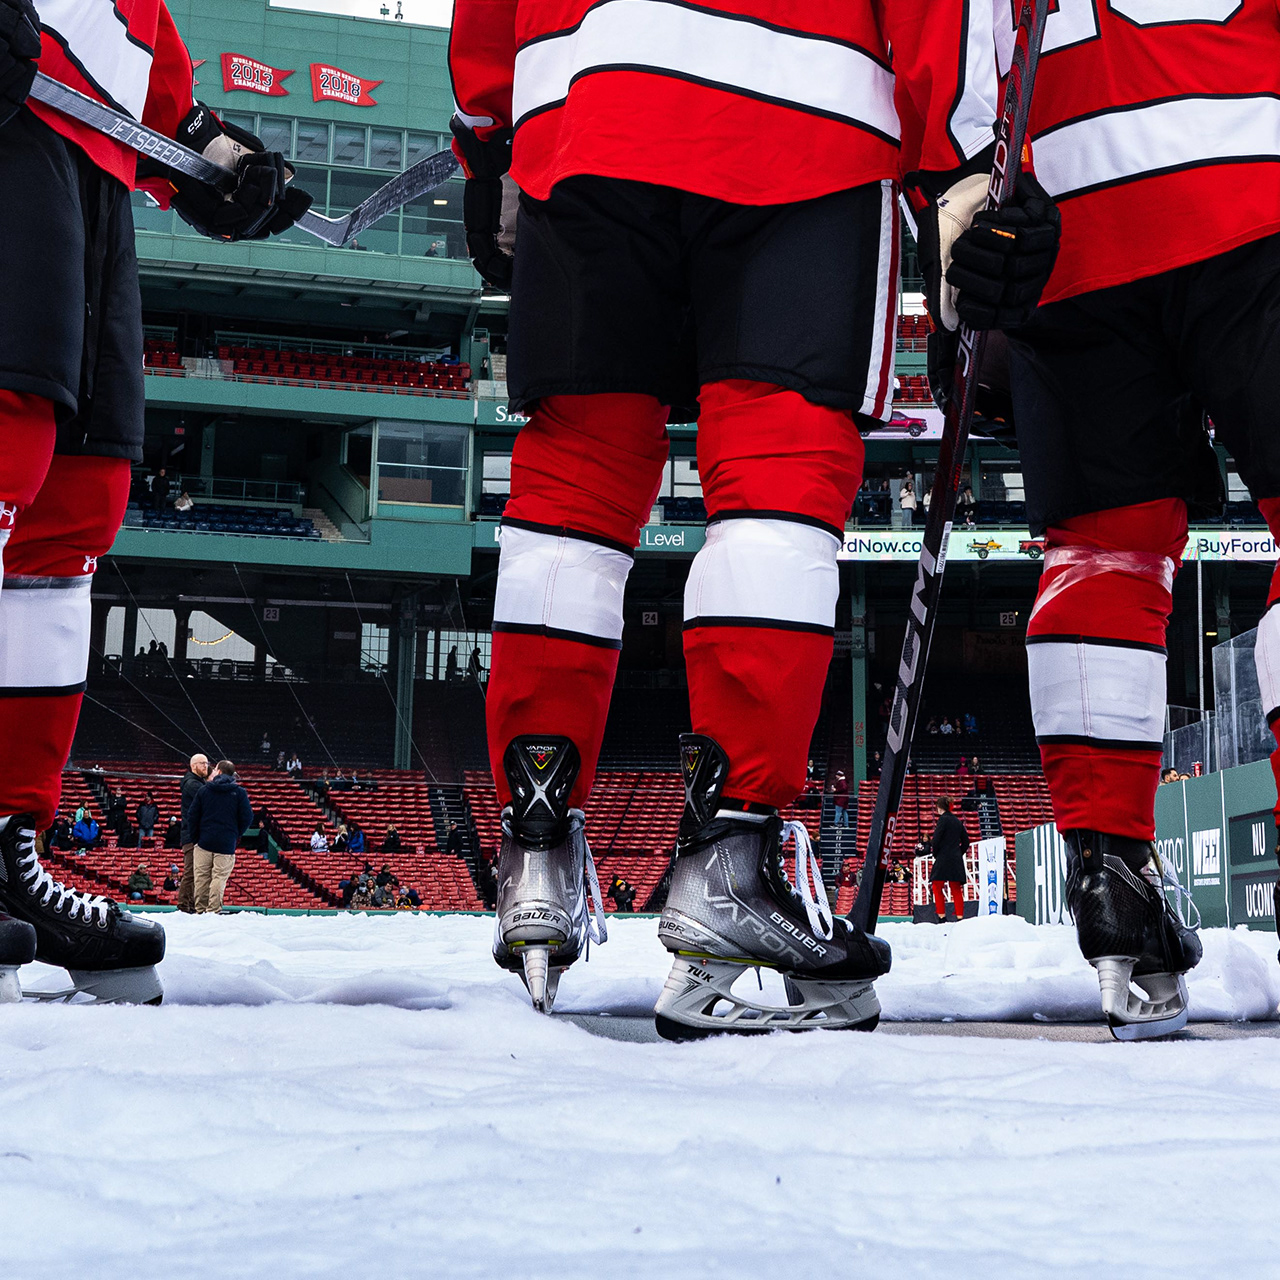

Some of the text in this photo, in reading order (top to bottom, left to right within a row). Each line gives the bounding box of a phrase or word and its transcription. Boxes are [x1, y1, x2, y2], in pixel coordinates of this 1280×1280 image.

[232, 56, 253, 67] WORLD
[230, 63, 274, 87] 2013
[320, 67, 341, 77] WORLD
[233, 79, 270, 93] CHAMPIONS
[319, 73, 362, 97] 2018
[322, 89, 359, 103] CHAMPIONS
[187, 110, 205, 134] CCM
[102, 117, 185, 169] JETSPEED
[645, 530, 686, 547] Level
[265, 609, 278, 620] 23
[643, 613, 657, 625] 24
[1001, 614, 1015, 626] 25
[854, 721, 865, 733] 24
[854, 735, 865, 746] 25
[880, 815, 897, 866] CCM
[1251, 821, 1267, 857] NU
[511, 910, 562, 925] BAUER
[703, 879, 806, 966] VAPOR
[769, 910, 829, 958] BAUER
